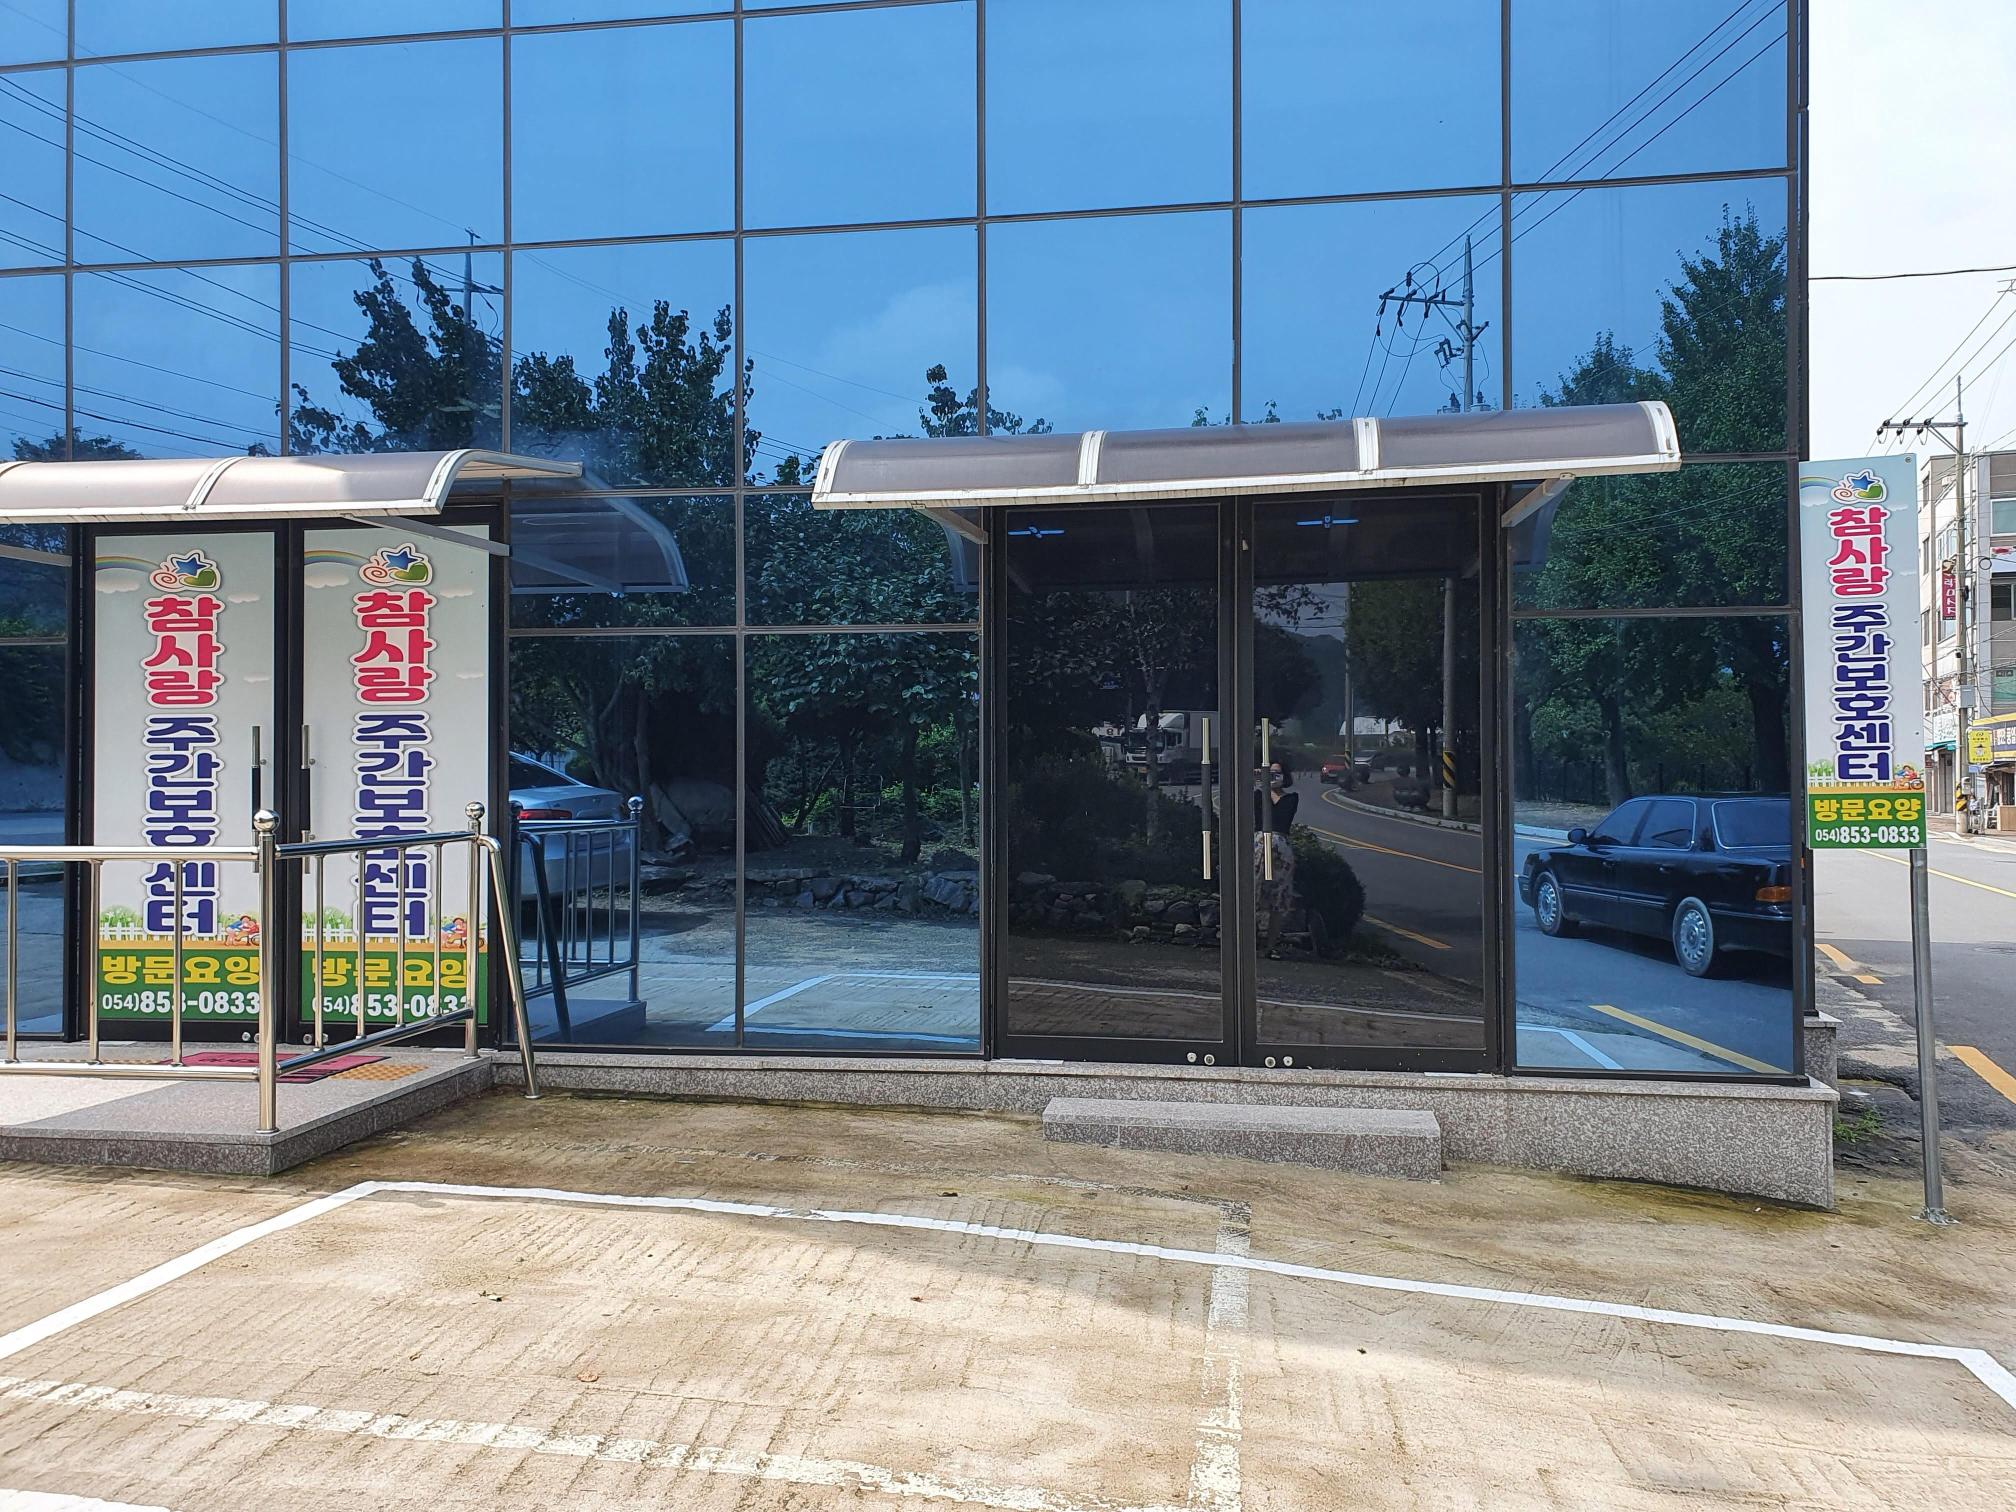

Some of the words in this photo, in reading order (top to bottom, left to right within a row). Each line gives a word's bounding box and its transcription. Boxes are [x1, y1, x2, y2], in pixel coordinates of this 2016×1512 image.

[1828, 507, 1887, 595] 참사랑
[144, 597, 221, 705] 참사랑
[353, 591, 434, 702] 참사랑
[1833, 604, 1891, 781] 주간보호센터
[1814, 798, 1921, 821] 방문요양
[1815, 825, 1920, 844] 054)853-0833
[102, 955, 260, 985] 방문요양
